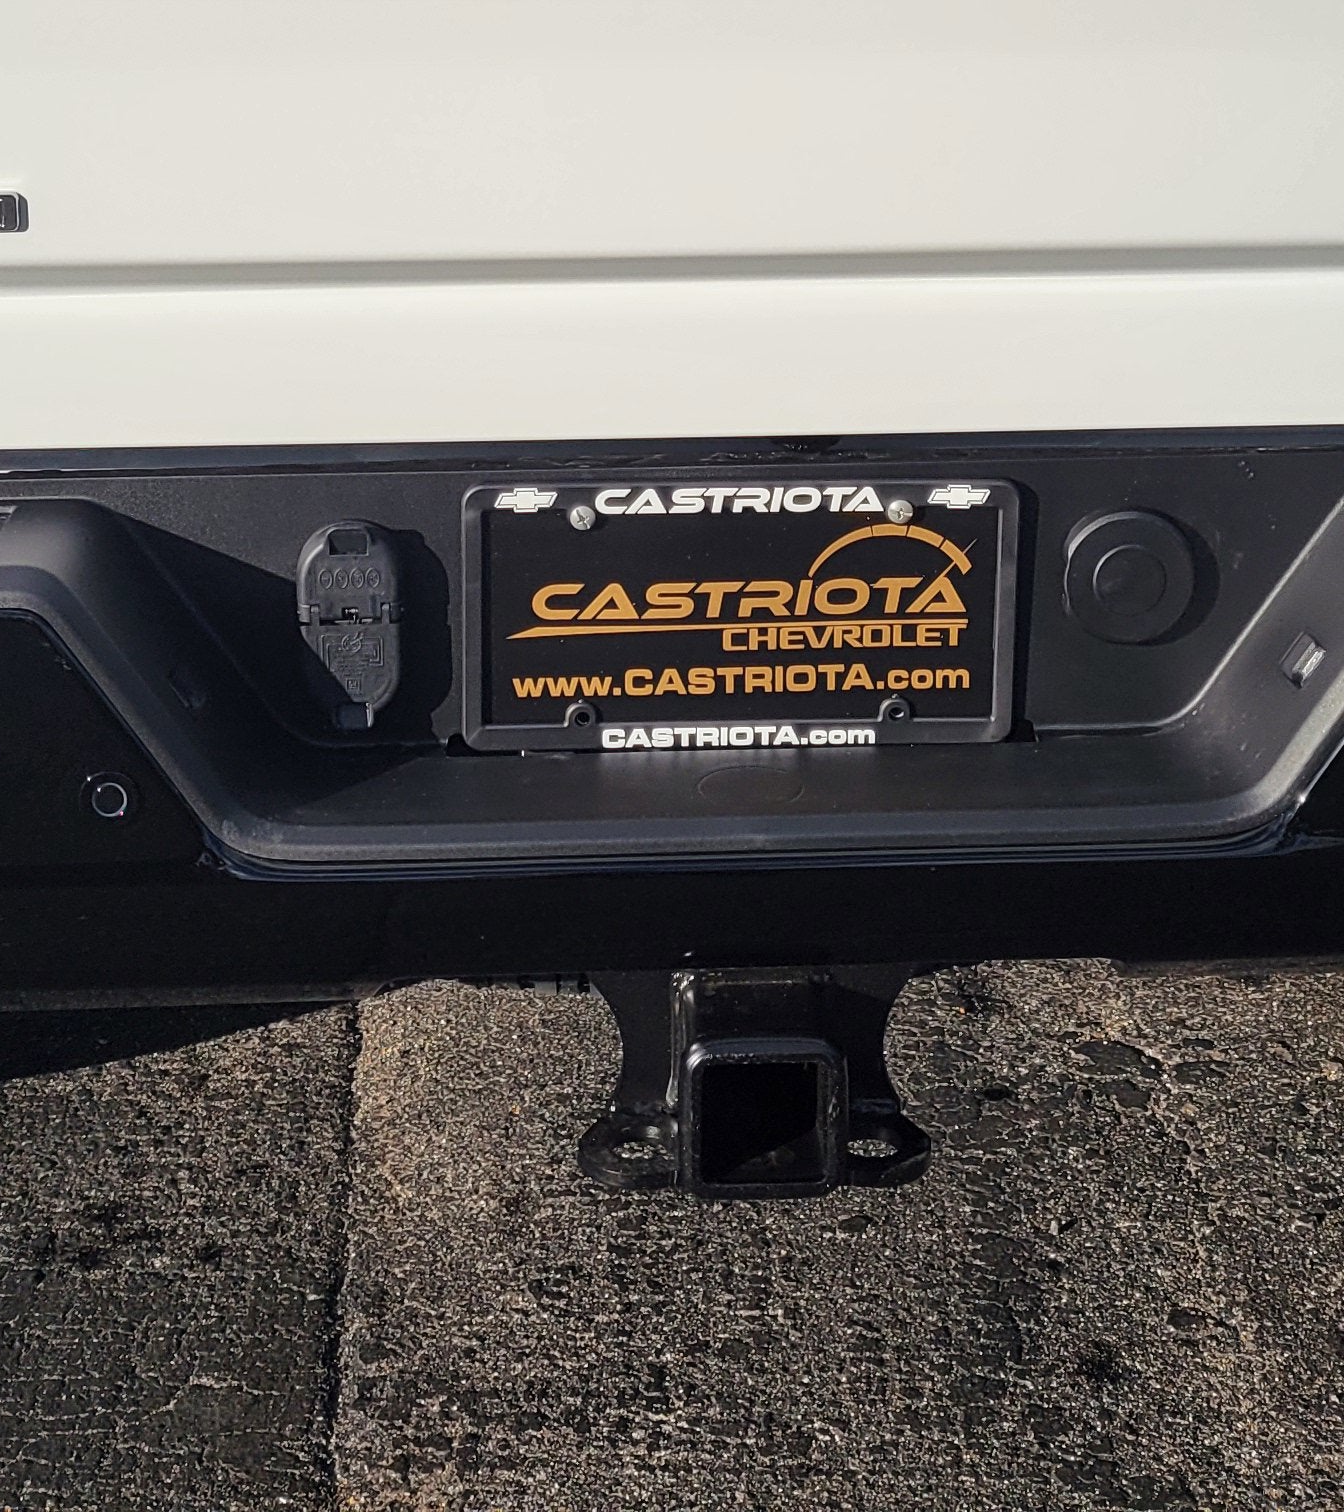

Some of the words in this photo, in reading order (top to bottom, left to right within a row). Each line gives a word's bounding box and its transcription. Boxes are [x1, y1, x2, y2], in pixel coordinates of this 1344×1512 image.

[594, 486, 885, 515] CASTRIOTA
[531, 576, 968, 620] CASTRIOTA
[722, 623, 964, 651] CHEVROLET
[513, 663, 970, 699] www.CASTRIOTA.com
[601, 725, 877, 750] CASTRIOTA.com
